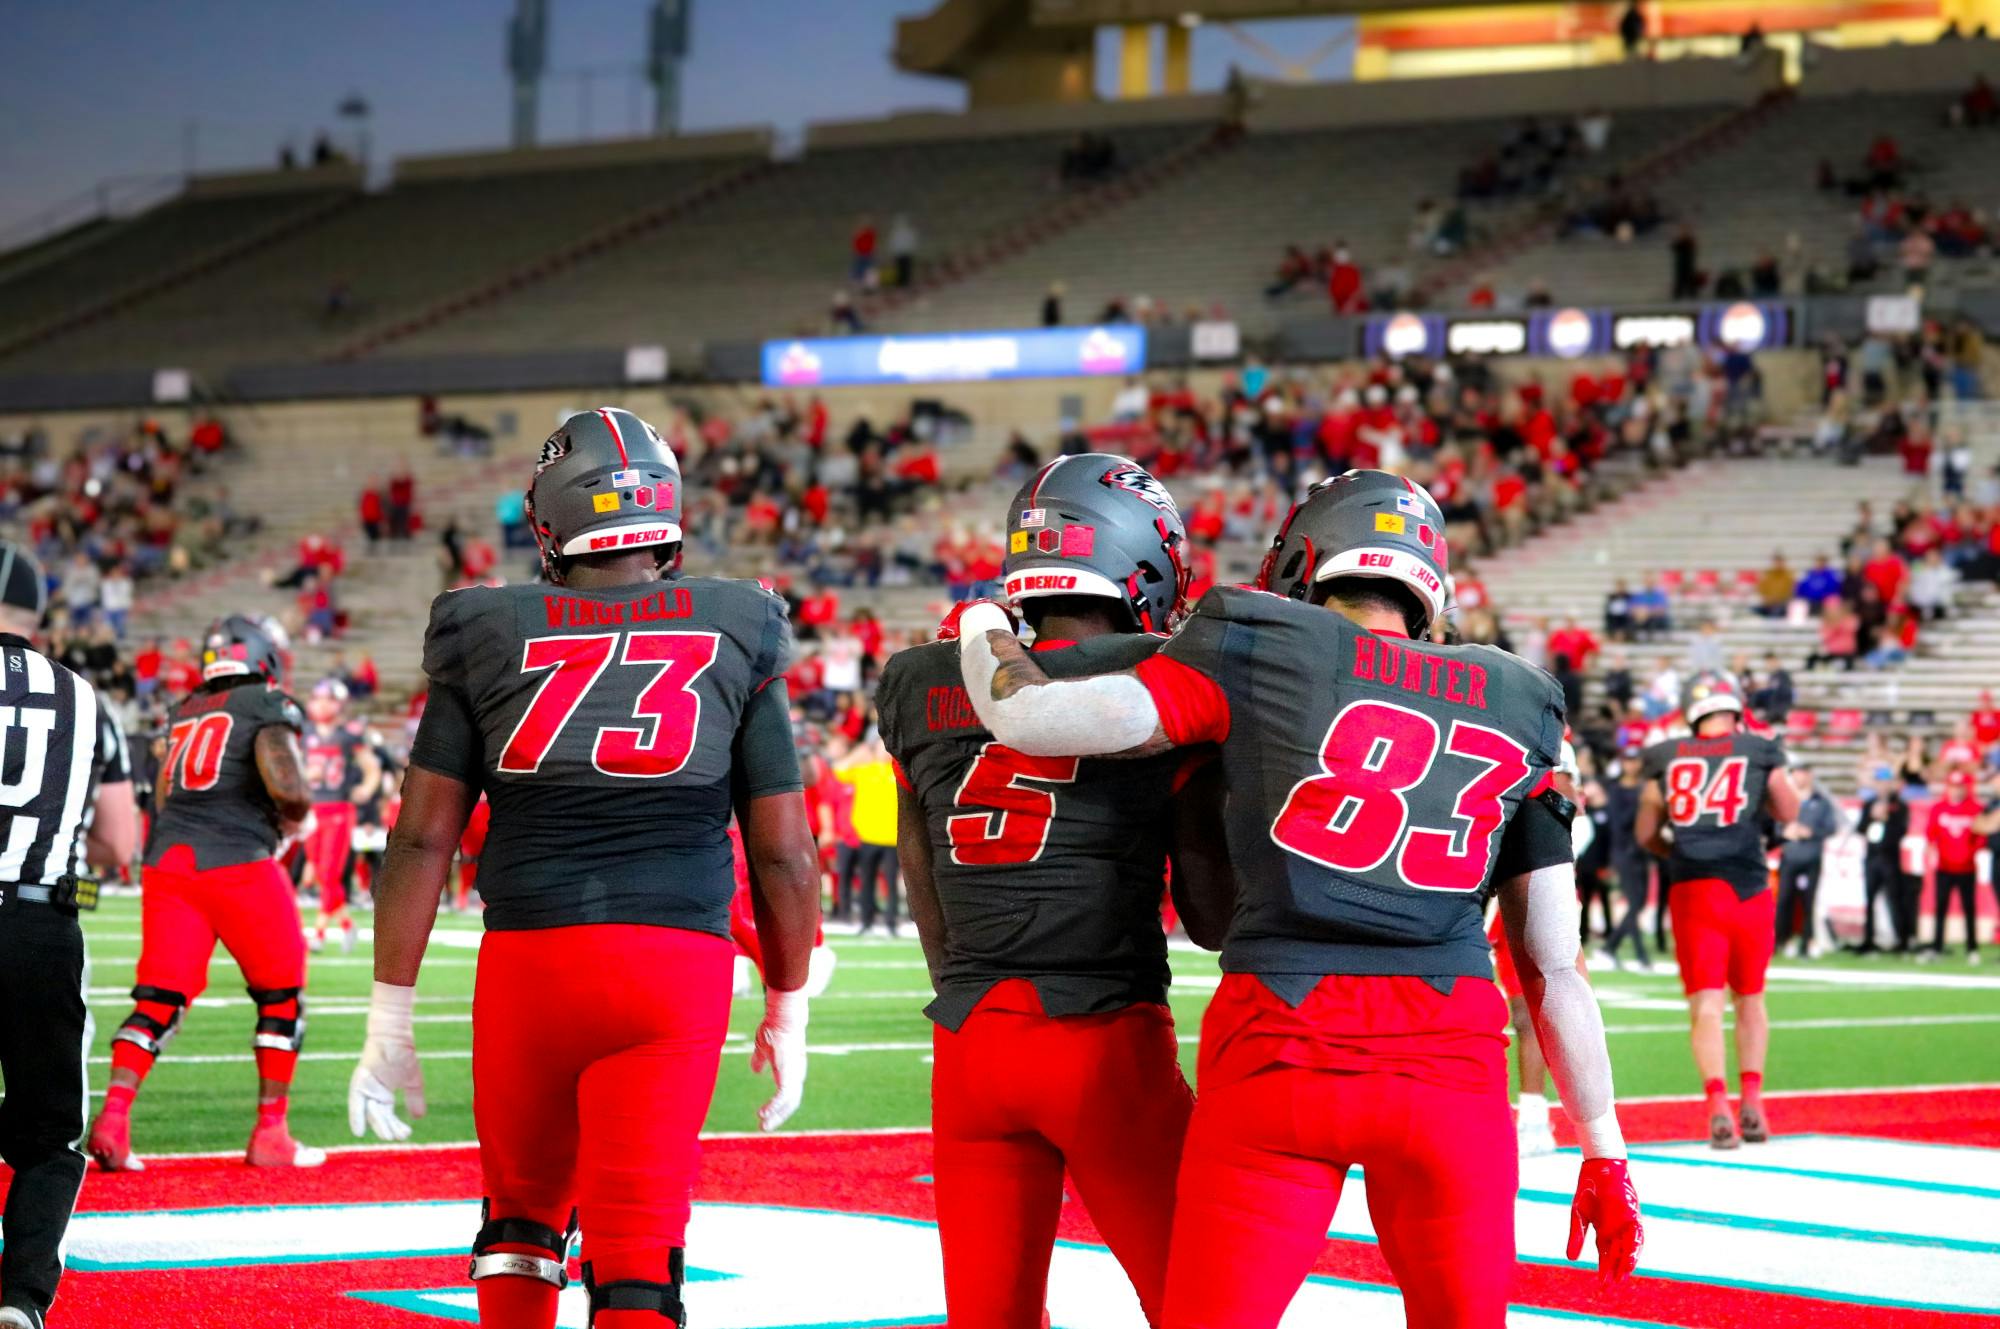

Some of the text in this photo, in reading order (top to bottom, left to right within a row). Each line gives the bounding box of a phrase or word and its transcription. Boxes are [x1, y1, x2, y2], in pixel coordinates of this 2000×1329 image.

[622, 529, 668, 545] MEXICO
[544, 587, 694, 629] WINGFIELD
[1024, 575, 1077, 590] MEXICO
[497, 631, 722, 779] 73
[1353, 635, 1488, 710] HUNTER
[166, 711, 234, 796] 70
[946, 741, 1080, 865] 5
[1270, 699, 1532, 893] 83
[1666, 757, 1749, 828] 84
